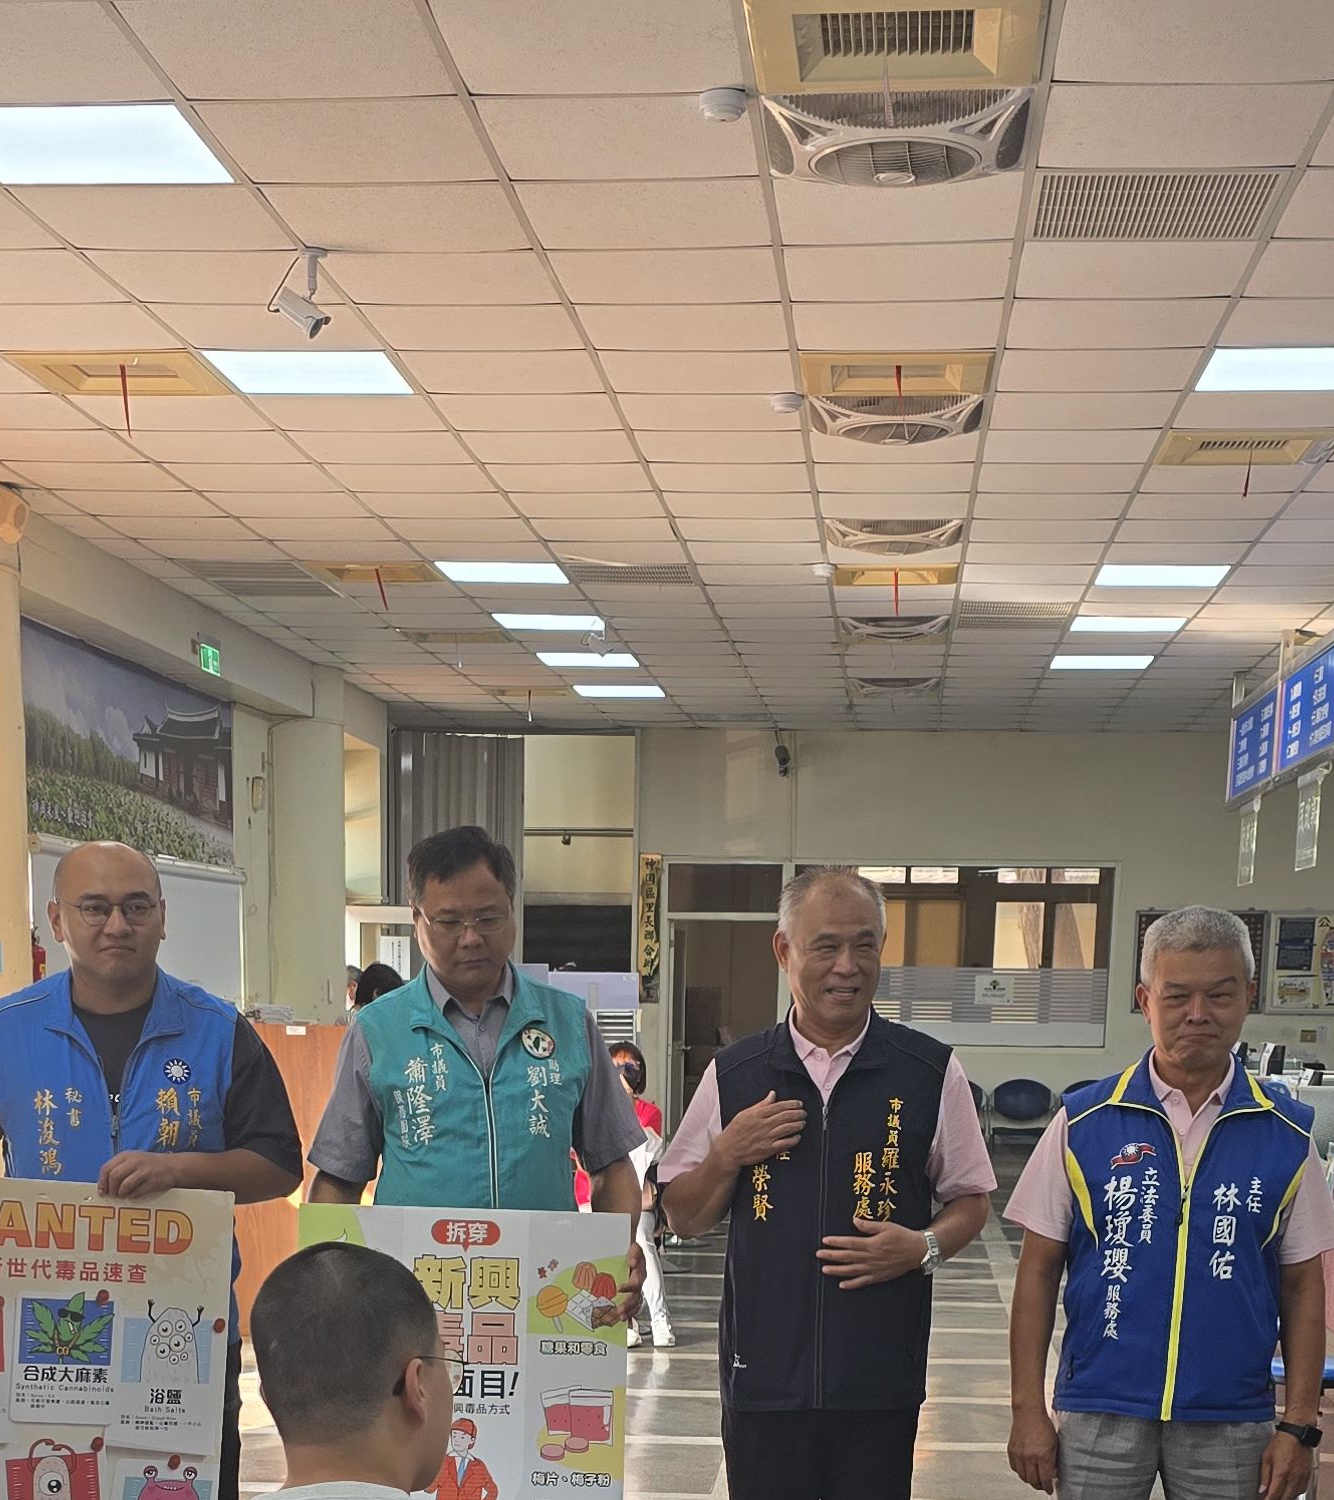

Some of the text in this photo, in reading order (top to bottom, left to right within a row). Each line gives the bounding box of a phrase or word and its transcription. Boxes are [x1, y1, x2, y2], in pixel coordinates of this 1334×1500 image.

[430, 1042, 449, 1092] 市議員
[547, 1058, 563, 1087] 助理
[64, 1087, 83, 1128] 秘書
[403, 1056, 436, 1146] 蕭隆澤
[526, 1064, 551, 1138] 劉大誠
[853, 1150, 877, 1221] 服務處
[1137, 1166, 1160, 1245] 立法委員
[1245, 1176, 1264, 1215] 主任
[445, 1220, 488, 1244] 拆穿
[1208, 1183, 1242, 1280] 林國佑
[412, 1253, 521, 1311] 新興
[1100, 1175, 1139, 1340] 楊瓊瓔 服務處
[15, 1383, 115, 1393] Synthetic Cannabinoids
[23, 1365, 109, 1384] 合成大麻素
[149, 1388, 182, 1405] 浴鹽
